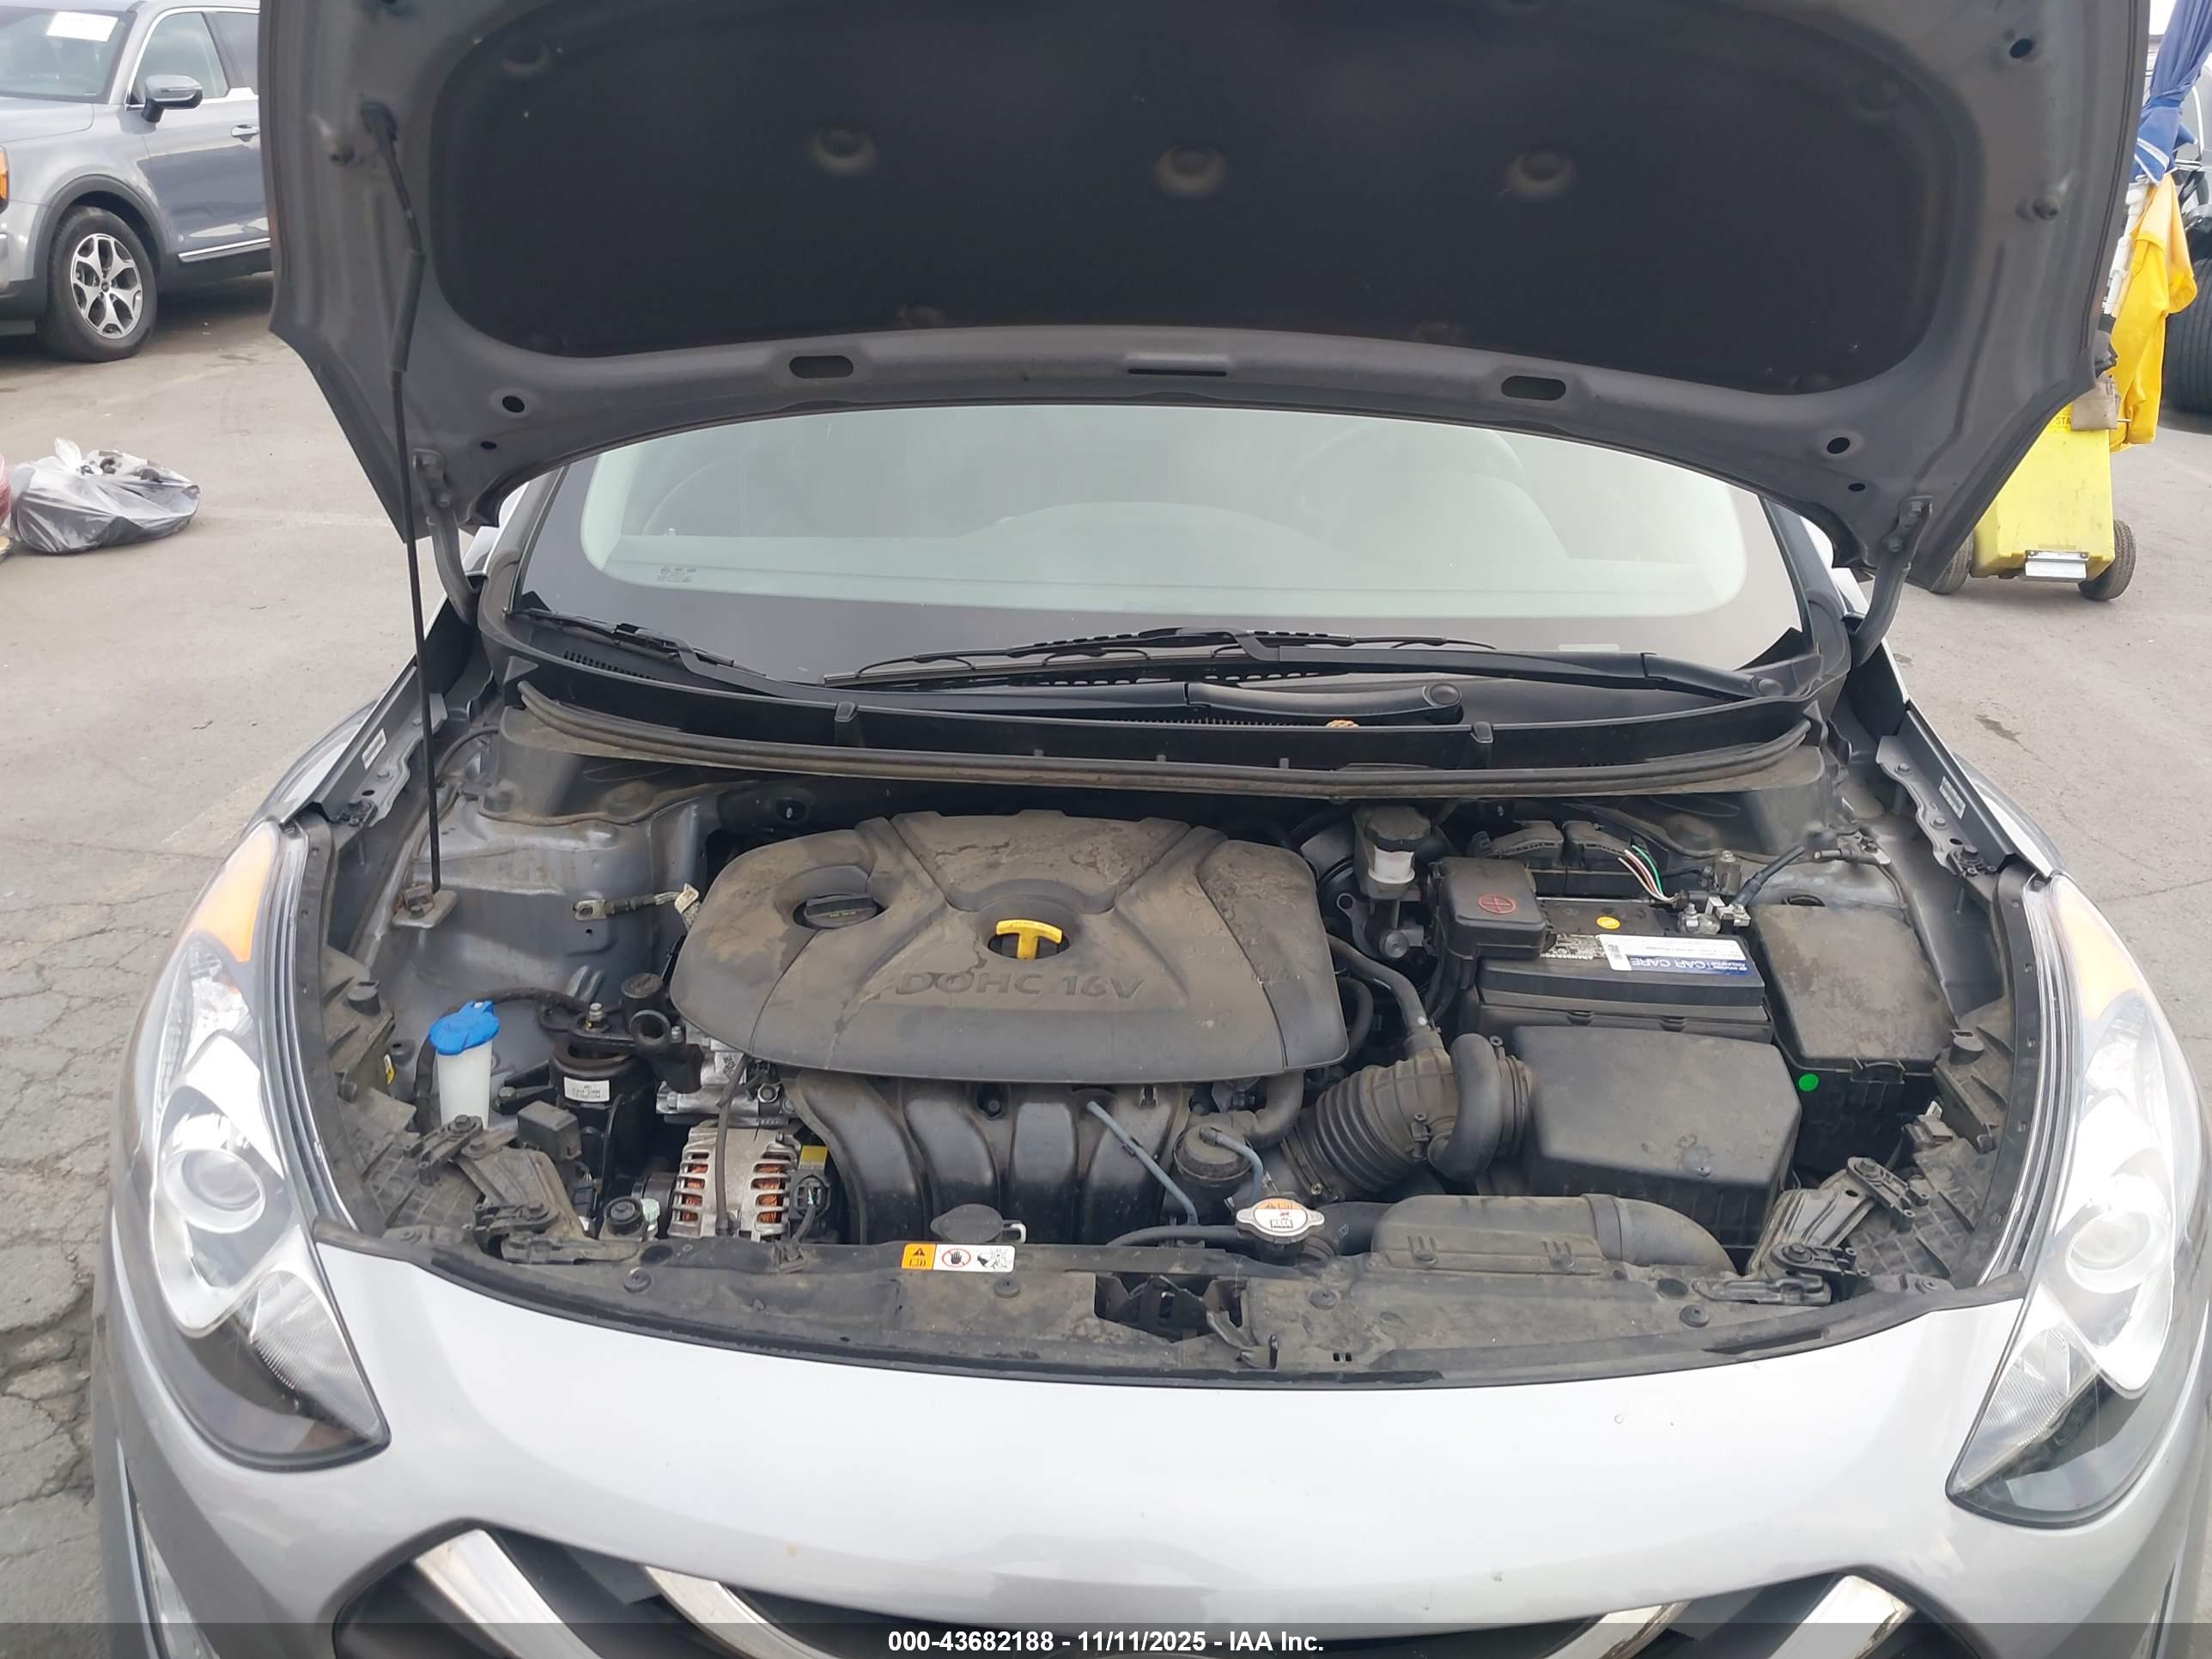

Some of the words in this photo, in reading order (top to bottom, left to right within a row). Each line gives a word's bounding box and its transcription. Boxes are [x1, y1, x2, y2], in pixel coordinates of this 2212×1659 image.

[1630, 957, 1671, 968] CARE
[1675, 958, 1708, 969] CAR
[896, 971, 1042, 995] DOHC
[1062, 975, 1145, 999] 16V
